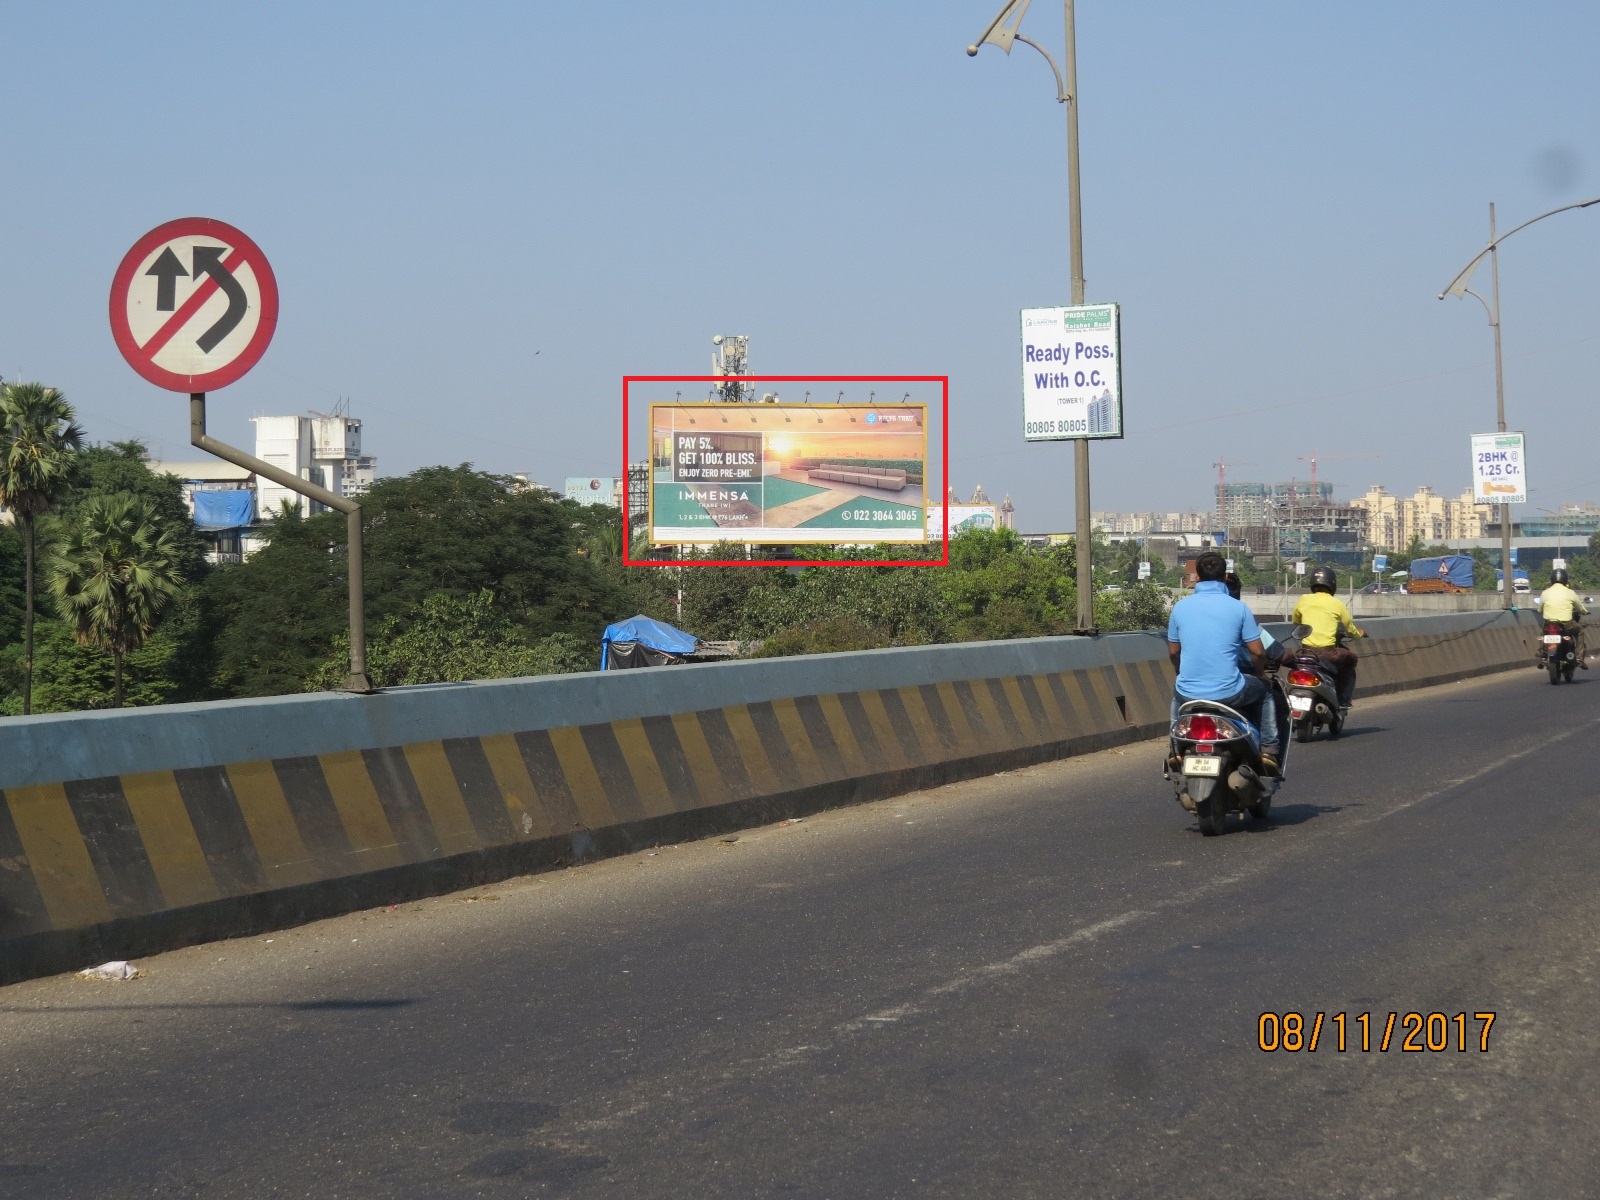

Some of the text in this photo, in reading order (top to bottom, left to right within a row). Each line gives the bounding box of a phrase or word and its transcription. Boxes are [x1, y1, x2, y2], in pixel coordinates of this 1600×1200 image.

[1026, 342, 1113, 365] Ready Poss.
[1035, 370, 1105, 389] With O.C.
[1057, 398, 1078, 406] (TOWER
[1027, 420, 1086, 434] 80805 80805
[679, 437, 714, 449] PAY 5%.
[679, 453, 757, 464] GET 100% BLISS.
[1478, 452, 1507, 463] 2BHK
[679, 469, 700, 477] ENJOY
[702, 469, 718, 477] ZERO
[1479, 464, 1520, 476] 1.25 Cr.
[680, 490, 749, 500] IMMENSA
[1502, 495, 1524, 503] 80805
[854, 510, 916, 520] 022 3064 3065
